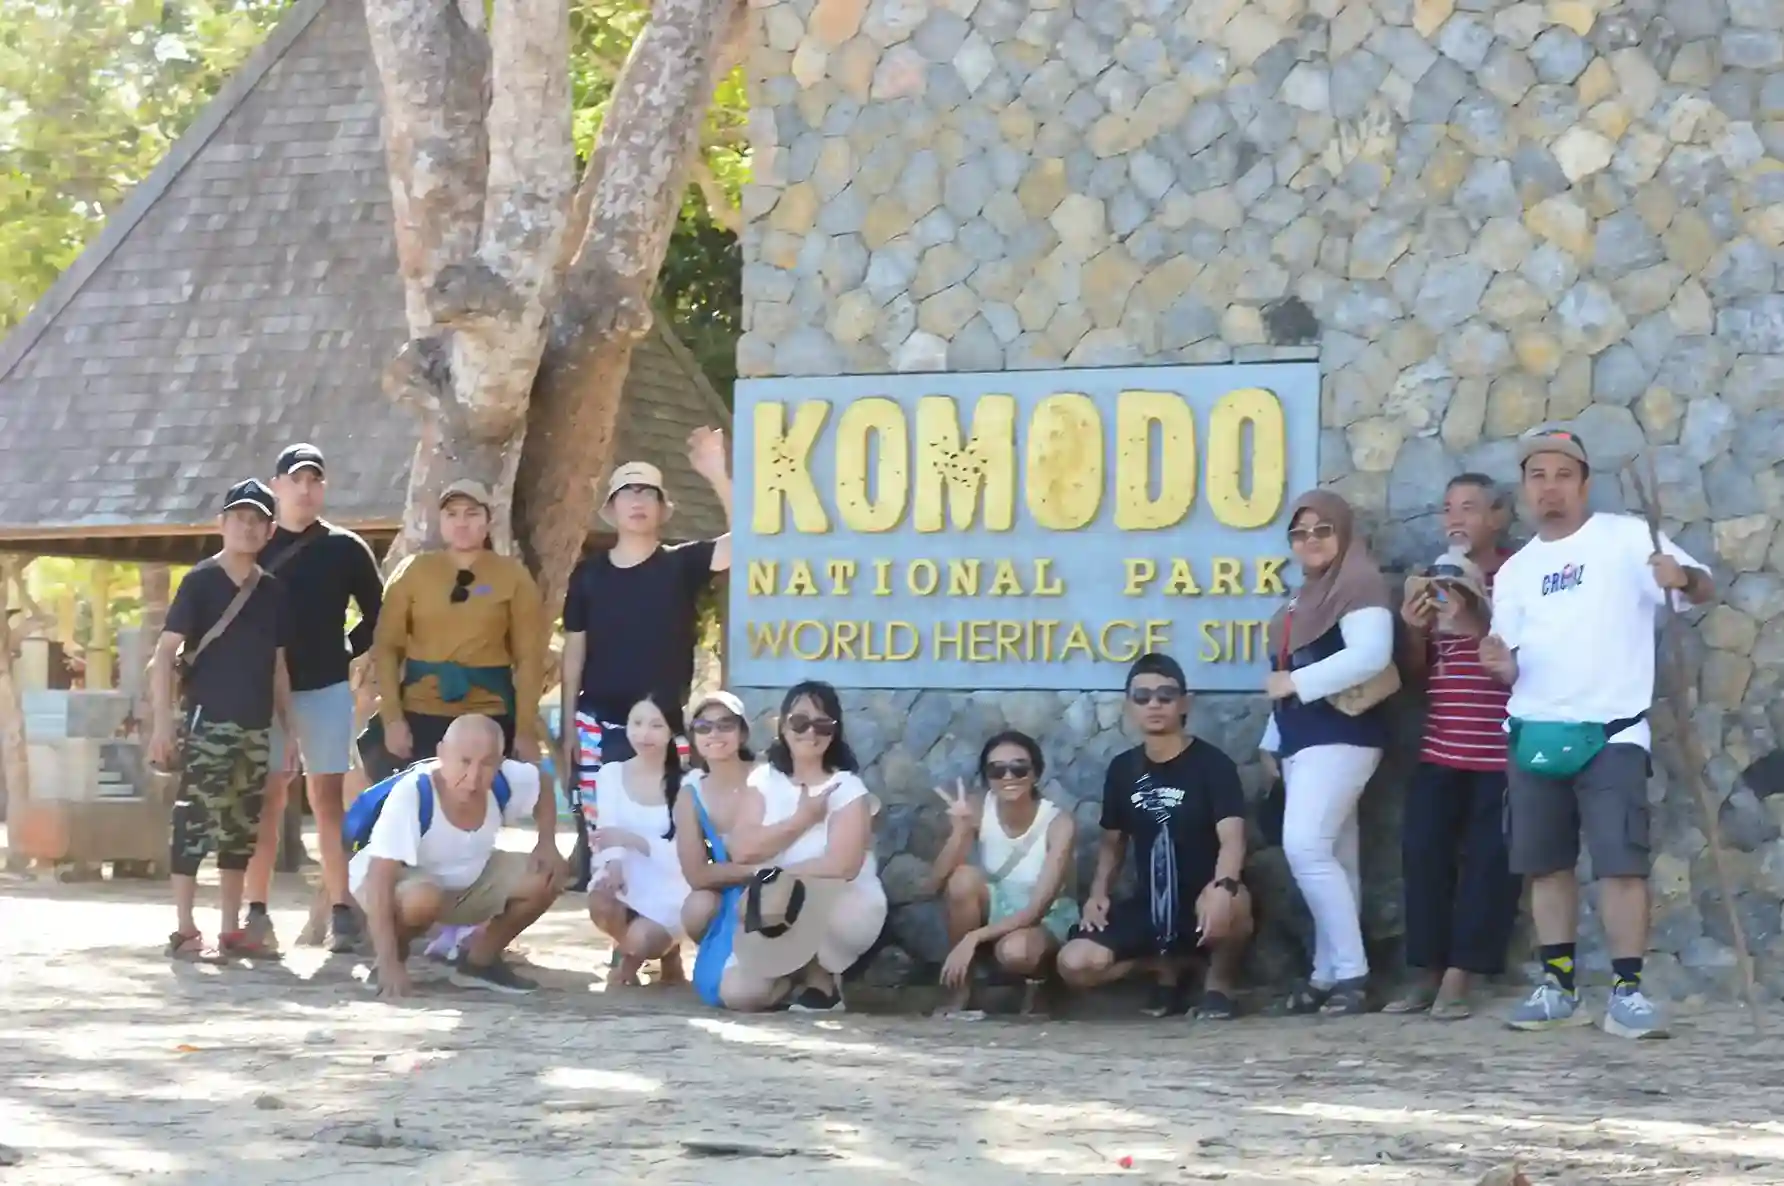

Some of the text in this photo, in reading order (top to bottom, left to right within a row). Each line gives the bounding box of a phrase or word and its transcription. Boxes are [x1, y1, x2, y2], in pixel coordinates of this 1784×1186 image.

[752, 388, 1286, 534] KOMODO
[748, 556, 1288, 597] NATIONAL PARK
[746, 619, 920, 662] WORLD
